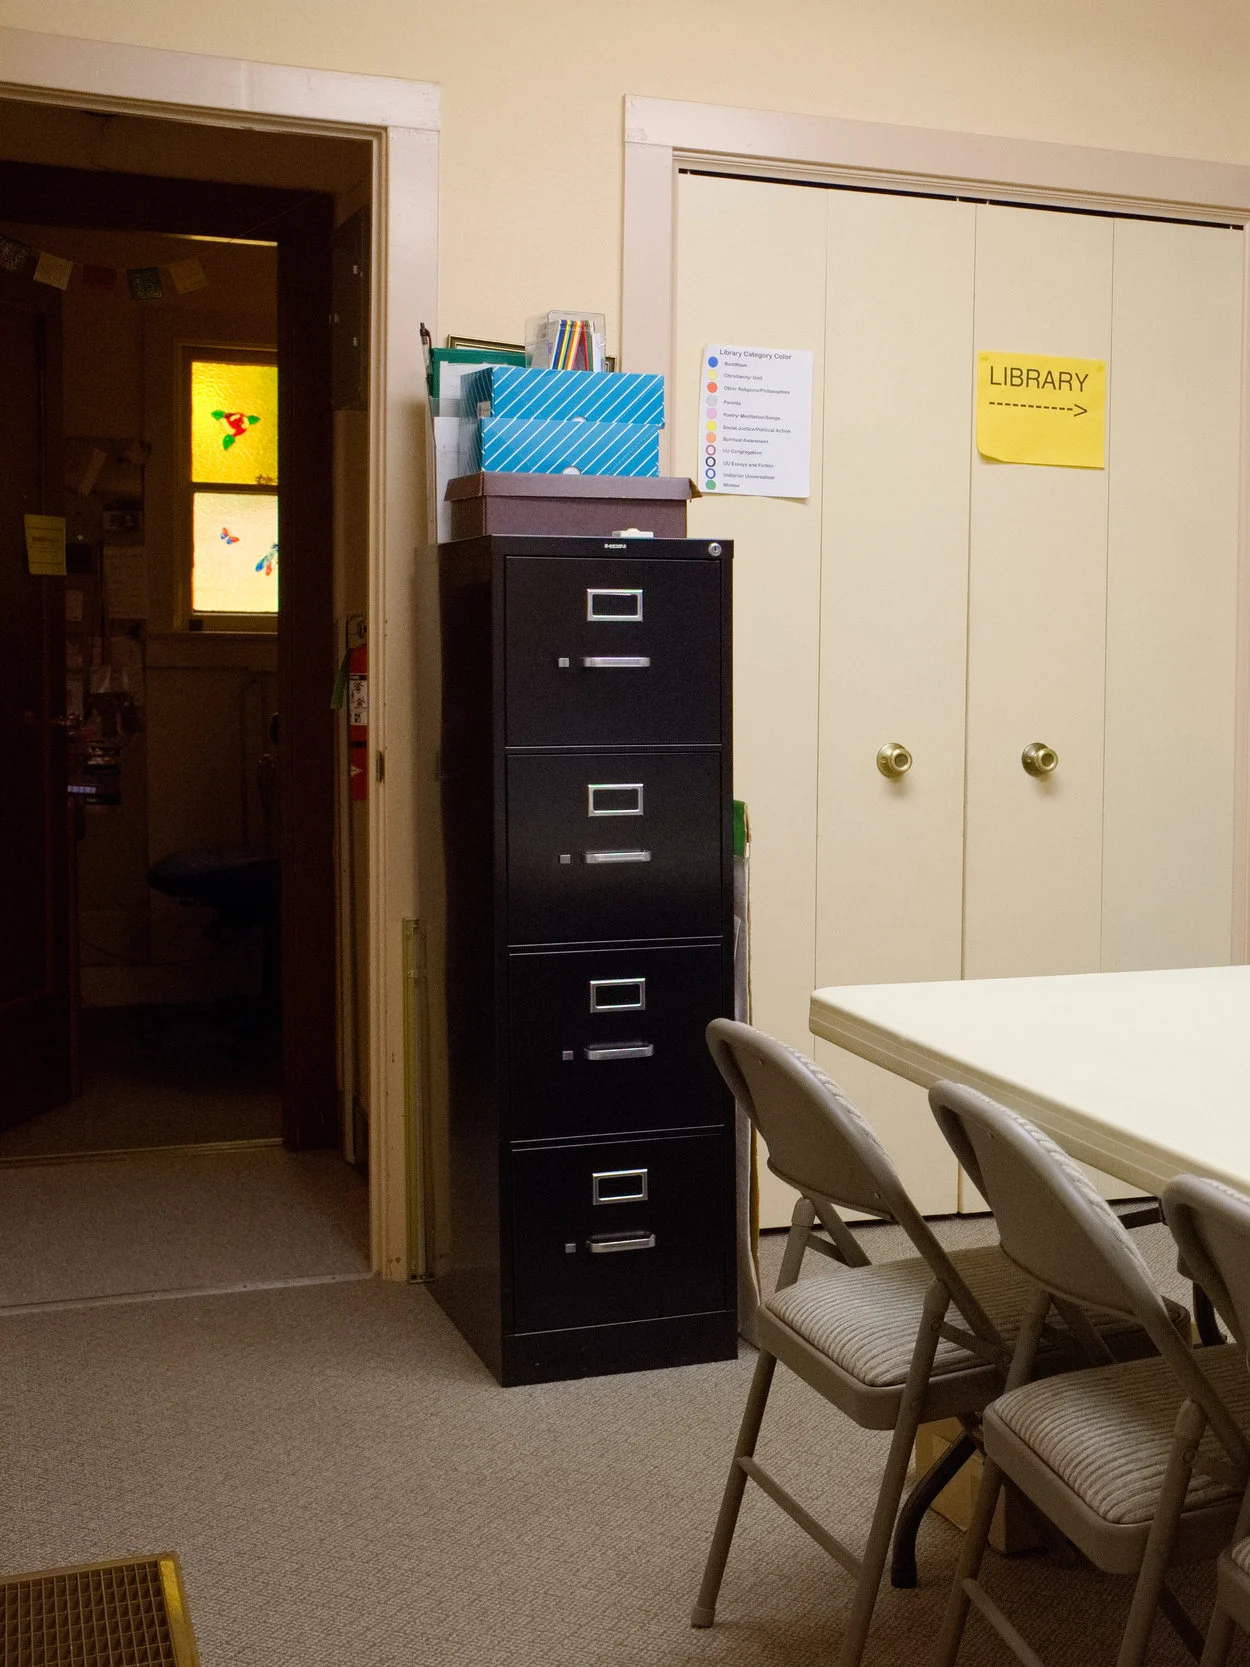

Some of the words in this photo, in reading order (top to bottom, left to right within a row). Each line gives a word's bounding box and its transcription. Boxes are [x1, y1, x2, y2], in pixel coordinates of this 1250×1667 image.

[719, 349, 742, 358] Library
[743, 351, 772, 360] Category
[774, 352, 792, 360] Color
[989, 366, 1089, 393] LIBRARY
